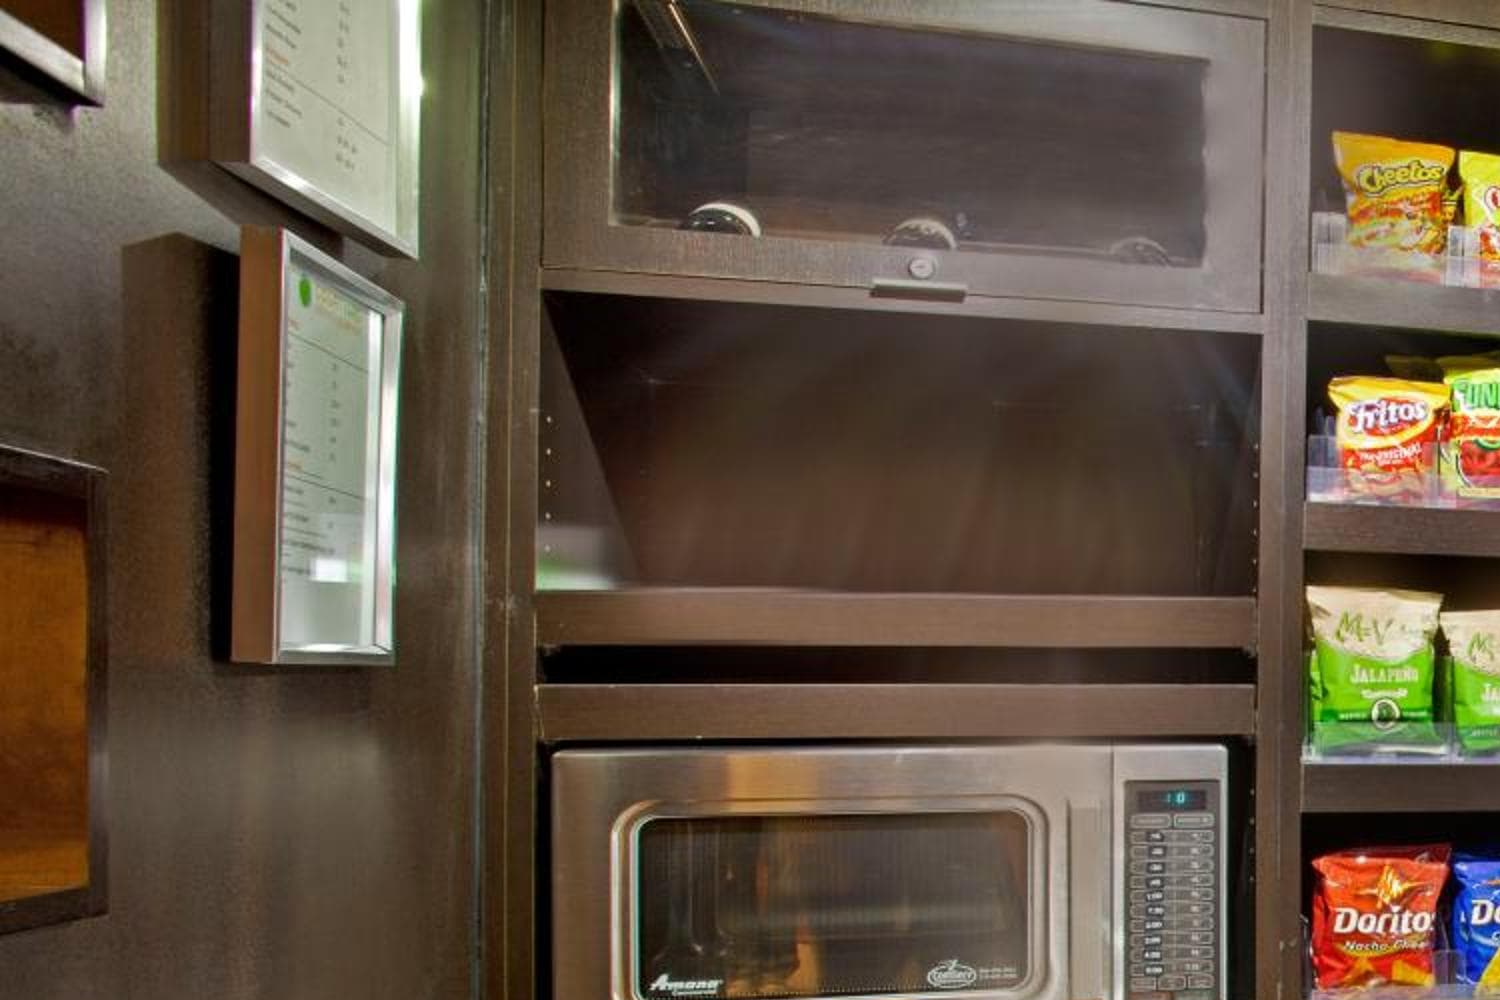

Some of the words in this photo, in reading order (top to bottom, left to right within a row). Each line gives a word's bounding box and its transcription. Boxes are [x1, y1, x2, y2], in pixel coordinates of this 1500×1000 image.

[1358, 160, 1444, 196] Cheetos
[1350, 400, 1425, 432] Fritos
[650, 973, 719, 991] Amana
